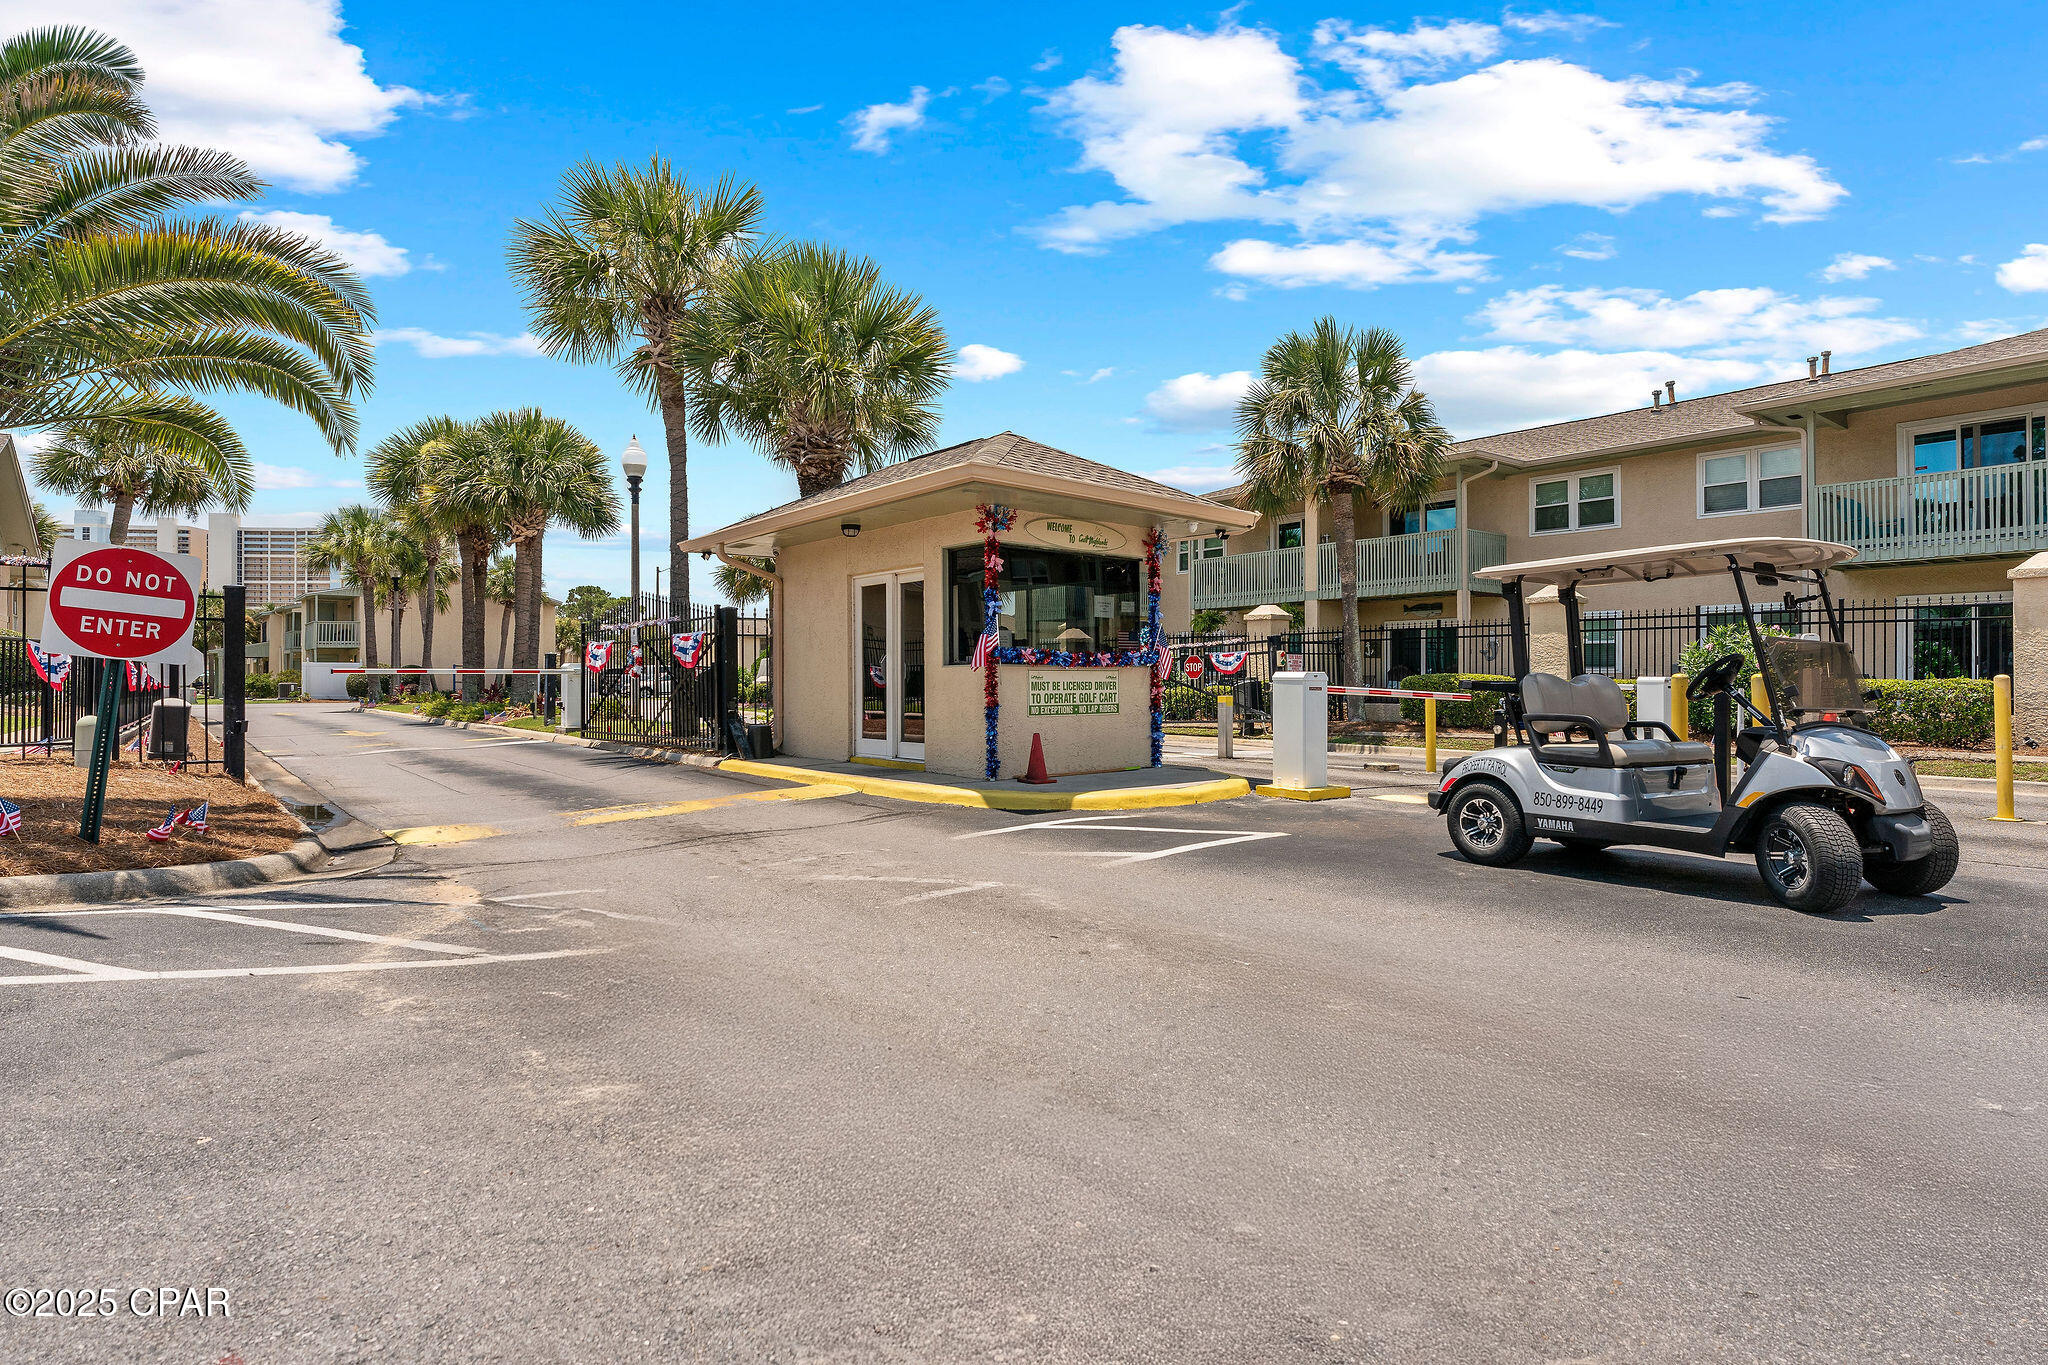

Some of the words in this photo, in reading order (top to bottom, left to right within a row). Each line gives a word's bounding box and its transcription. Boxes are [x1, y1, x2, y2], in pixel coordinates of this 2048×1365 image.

[1046, 521, 1073, 533] WELCOME
[1069, 534, 1076, 544] TO
[76, 564, 112, 585] DO
[125, 571, 177, 593] NOT
[79, 615, 161, 640] ENTER
[1185, 662, 1202, 672] STOP
[1031, 681, 1050, 691] MUST
[1052, 681, 1060, 691] BE
[1062, 681, 1092, 691] LICENSED
[1094, 681, 1117, 691] DRIVER
[1031, 693, 1041, 704] TO
[1044, 692, 1077, 704] OPERATE
[1078, 692, 1097, 703] GOLF
[1097, 692, 1117, 703] CART
[1031, 706, 1040, 715] NO
[1040, 705, 1074, 714] EXCEPTIONS
[1078, 705, 1087, 714] NO
[1087, 705, 1099, 713] LAP
[1099, 704, 1118, 713] RIDERS
[1461, 758, 1486, 775] PROPERTY
[1486, 759, 1507, 778] PATROL
[1533, 791, 1604, 814] 850-899-8449
[1536, 817, 1575, 832] YAMAHA
